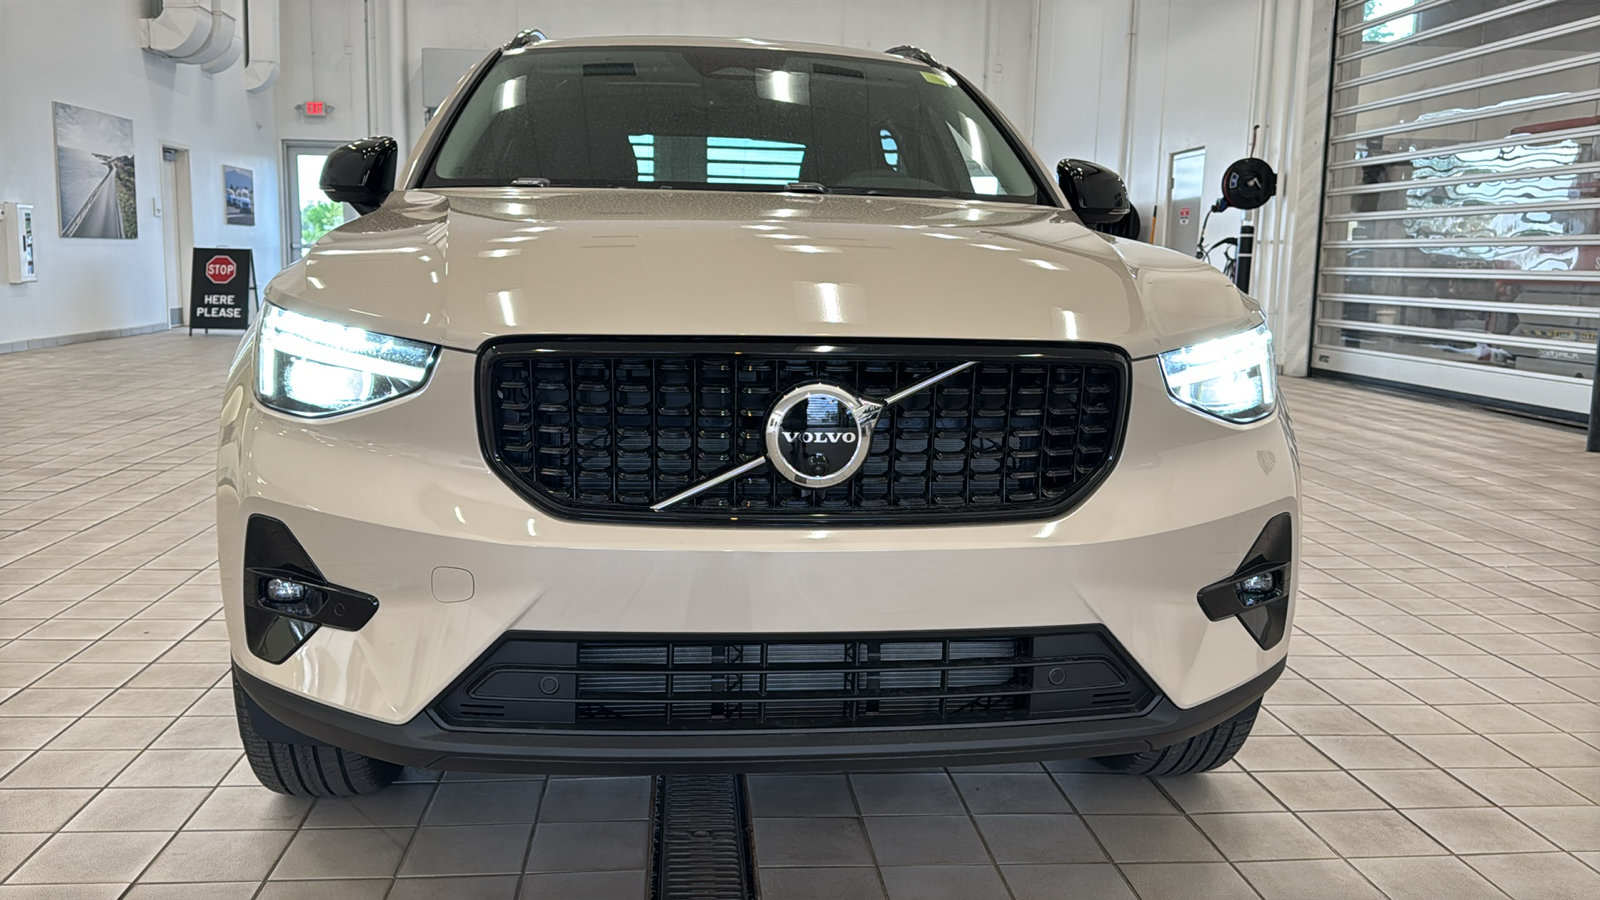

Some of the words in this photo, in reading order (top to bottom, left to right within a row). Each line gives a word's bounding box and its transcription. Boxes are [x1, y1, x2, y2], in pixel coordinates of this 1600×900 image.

[307, 101, 323, 114] EXIT
[208, 264, 234, 275] STOP
[204, 294, 235, 305] HERE
[196, 307, 241, 318] PLEASE
[782, 431, 856, 443] VOLVO
